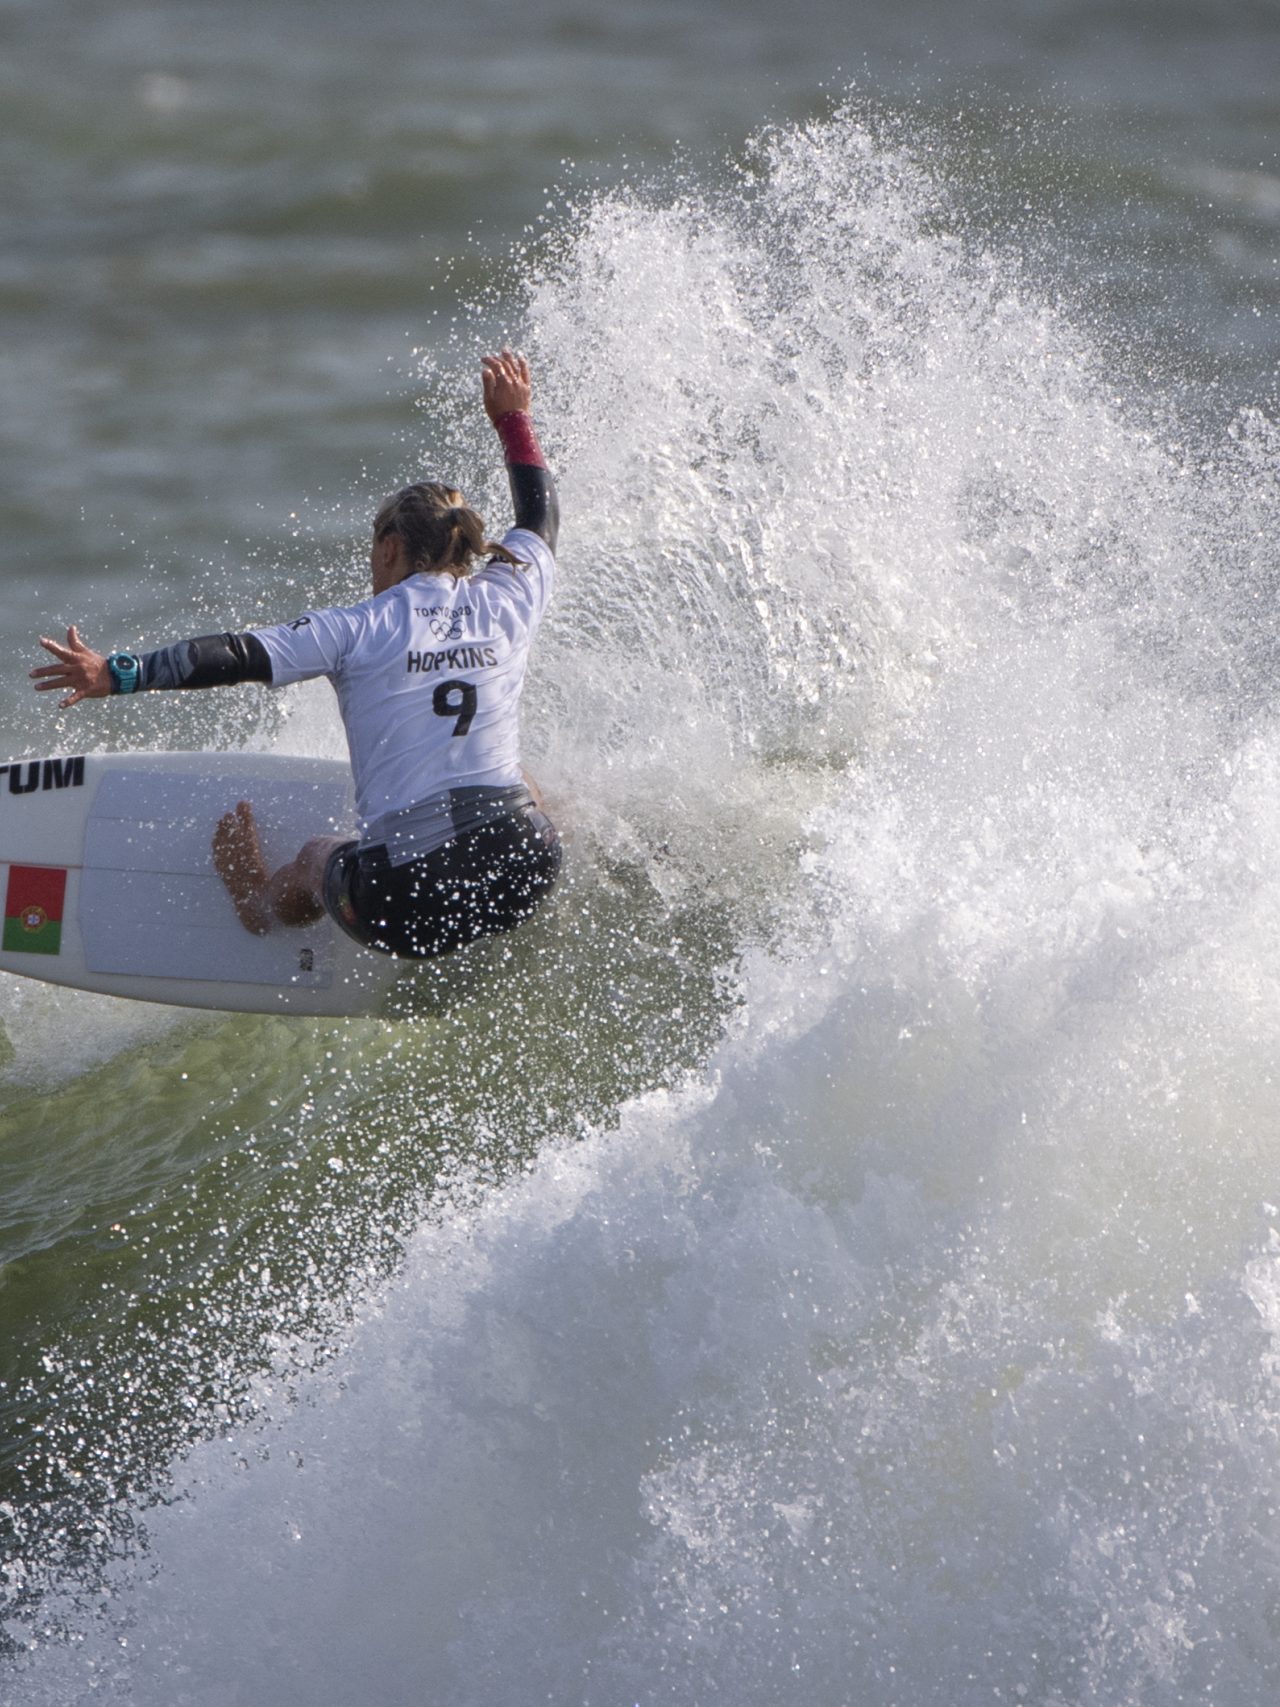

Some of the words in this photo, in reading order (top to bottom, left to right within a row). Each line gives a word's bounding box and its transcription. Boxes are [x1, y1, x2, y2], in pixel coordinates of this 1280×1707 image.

[414, 606, 449, 618] TOKYO
[407, 648, 498, 673] HOPKINS
[432, 680, 477, 737] 9
